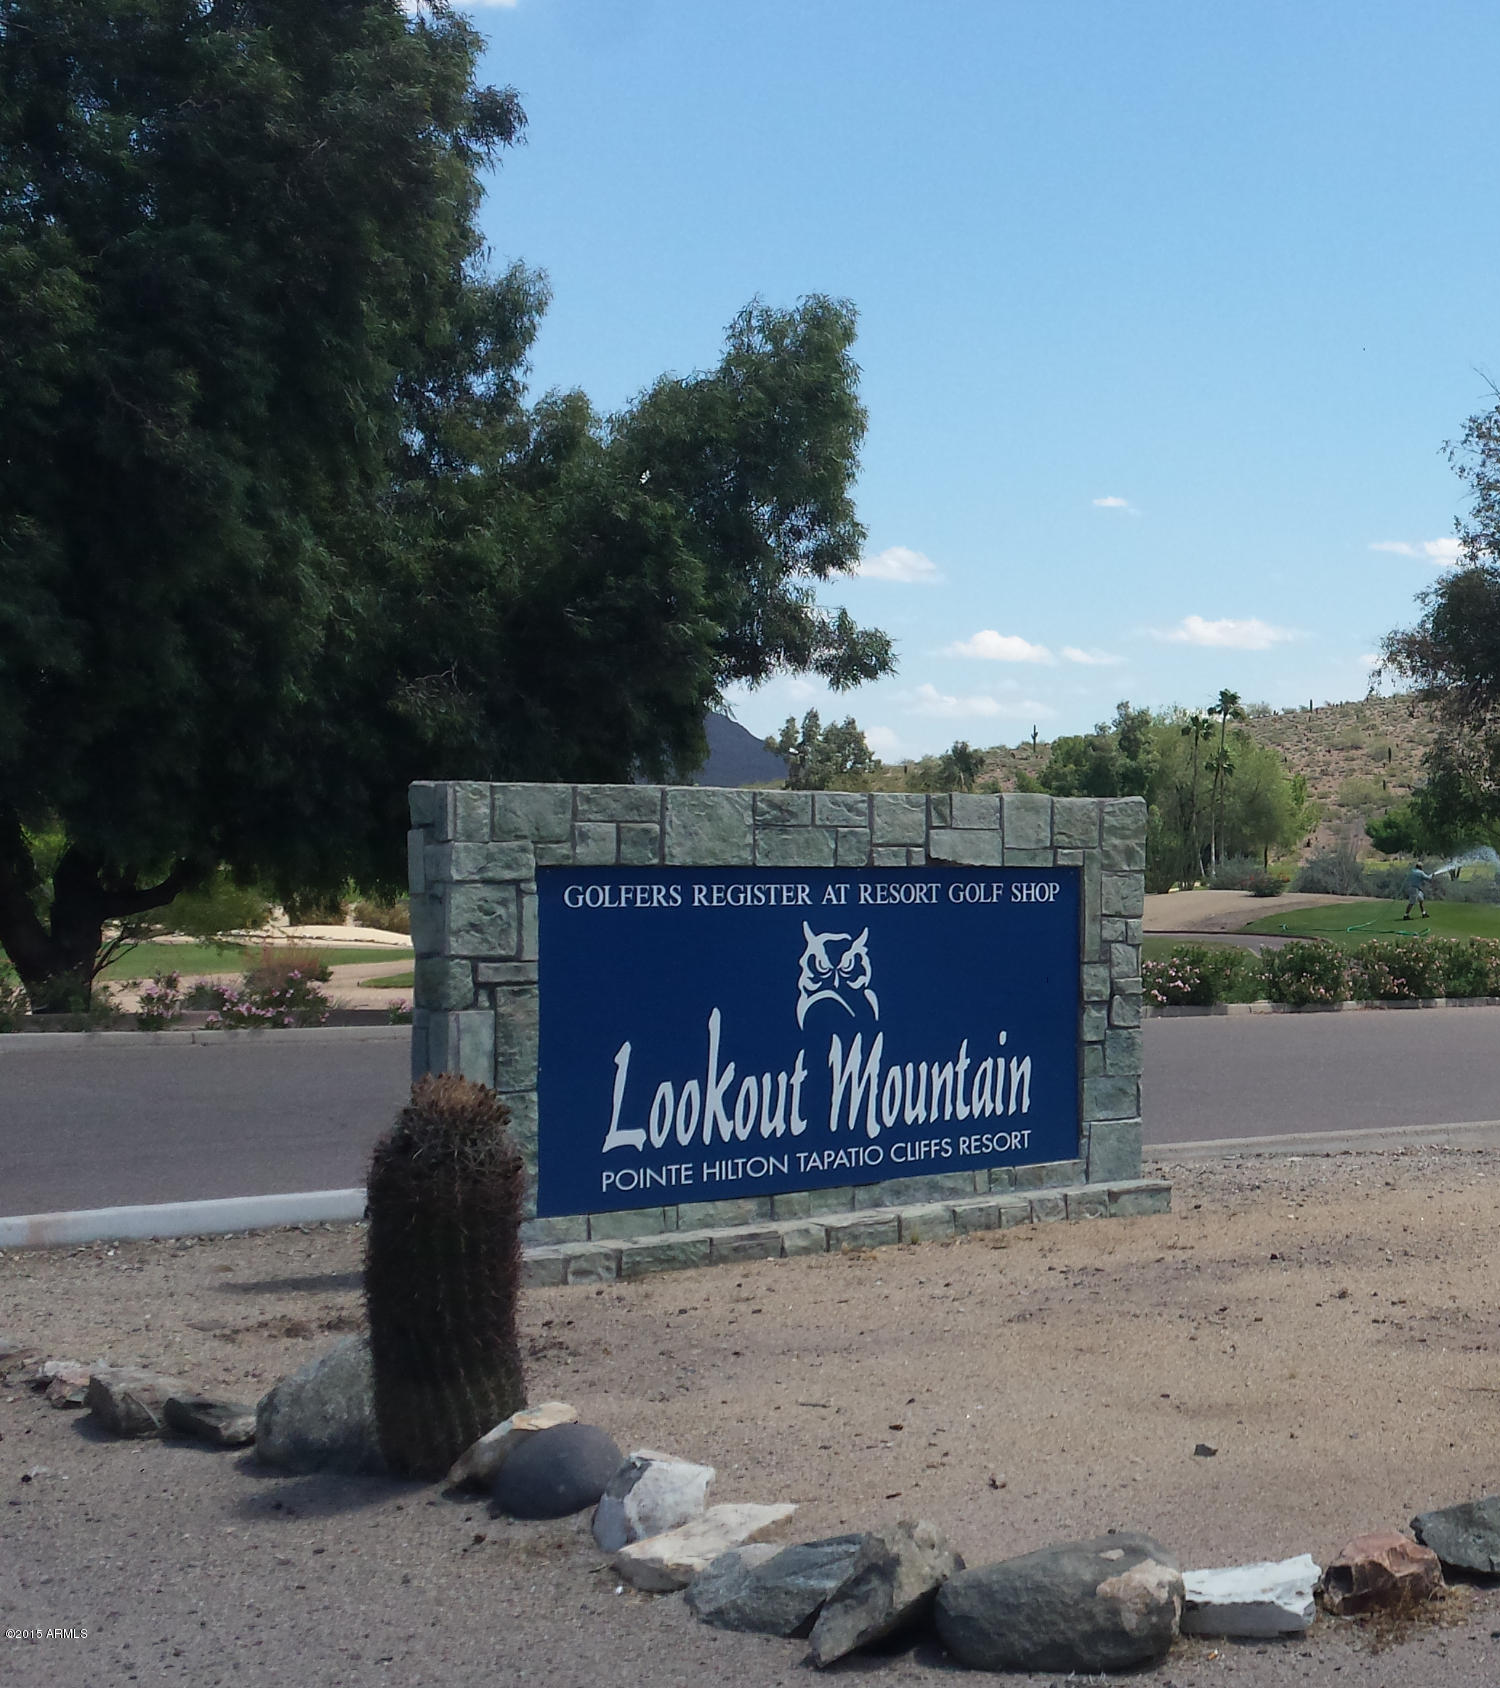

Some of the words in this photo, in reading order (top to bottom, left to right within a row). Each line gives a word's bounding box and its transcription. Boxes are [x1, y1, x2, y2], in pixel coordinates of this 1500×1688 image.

[563, 884, 682, 908] GOLFERS
[692, 884, 813, 907] REGISTER
[821, 883, 850, 905] AT
[858, 883, 941, 904] RESORT
[948, 883, 1004, 903] GOLF
[1011, 882, 1060, 903] SHOP
[602, 1007, 808, 1153] Lookout
[828, 1030, 1032, 1139] Mountain
[602, 1163, 693, 1193] POINTE
[703, 1154, 788, 1182] HILTON
[795, 1145, 884, 1173] TAPATIO
[890, 1138, 953, 1163] CLIFFS
[959, 1129, 1032, 1156] RESORT
